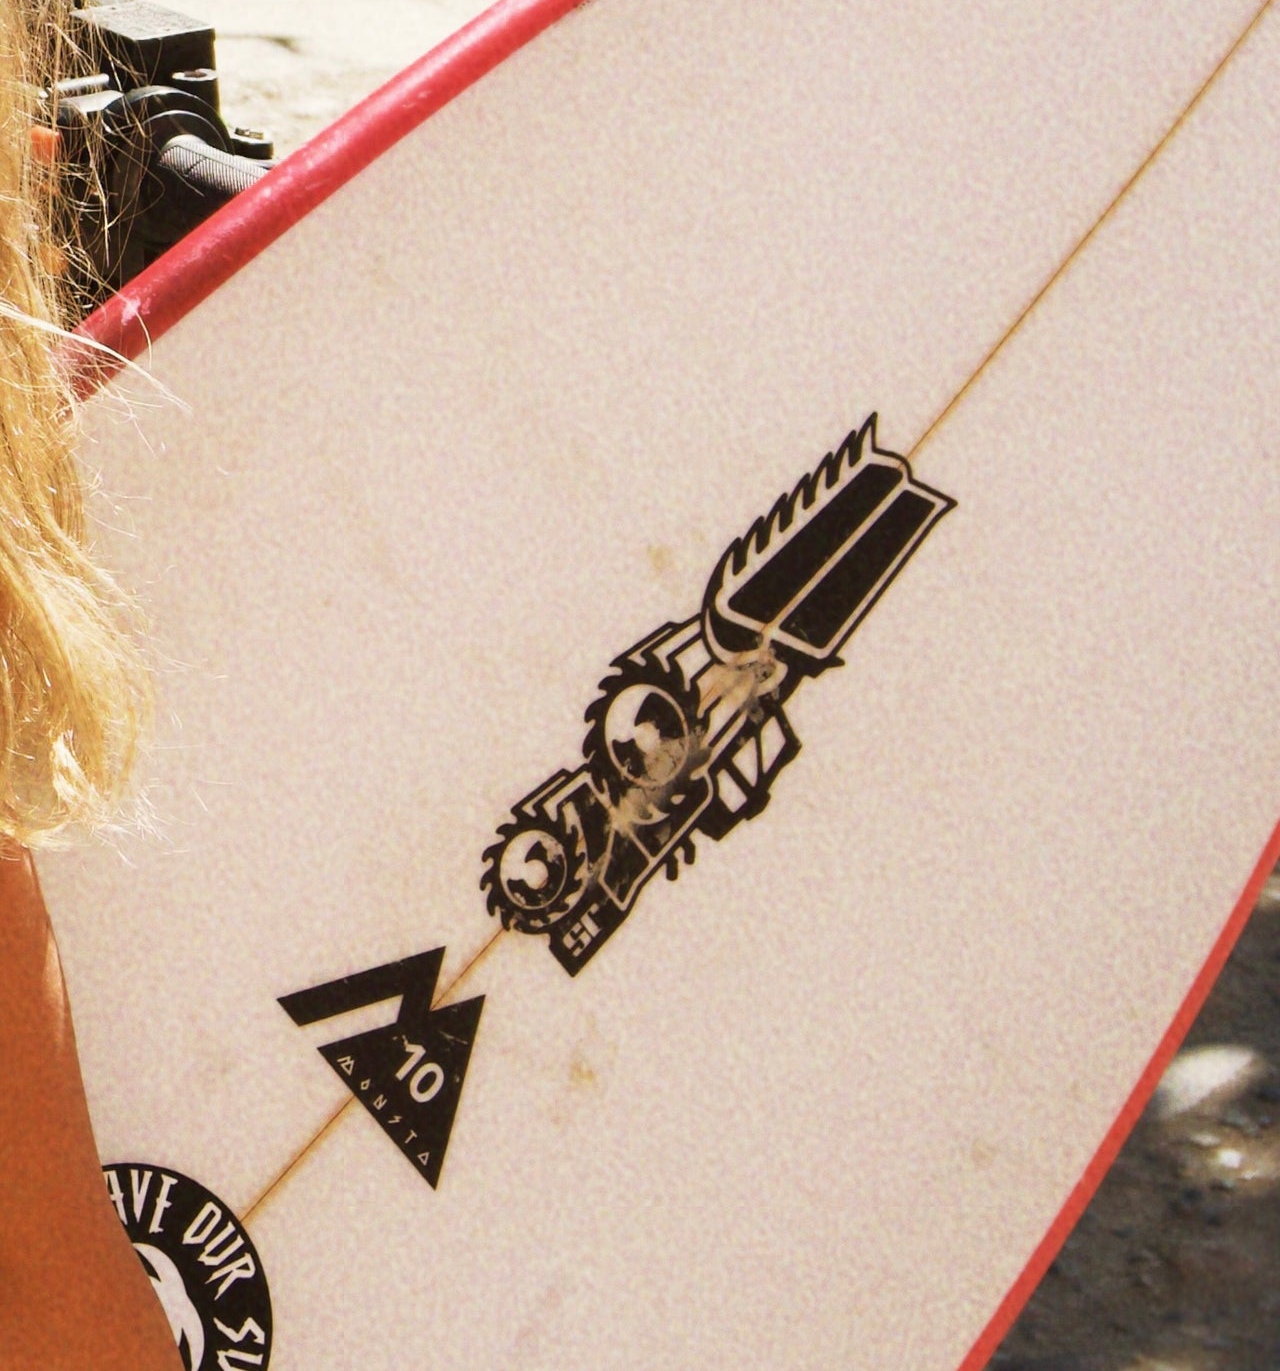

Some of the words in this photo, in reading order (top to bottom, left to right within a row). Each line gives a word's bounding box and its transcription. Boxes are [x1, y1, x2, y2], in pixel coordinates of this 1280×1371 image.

[394, 1042, 446, 1104] 10
[106, 1168, 179, 1235] AVE
[181, 1201, 258, 1302] OUR
